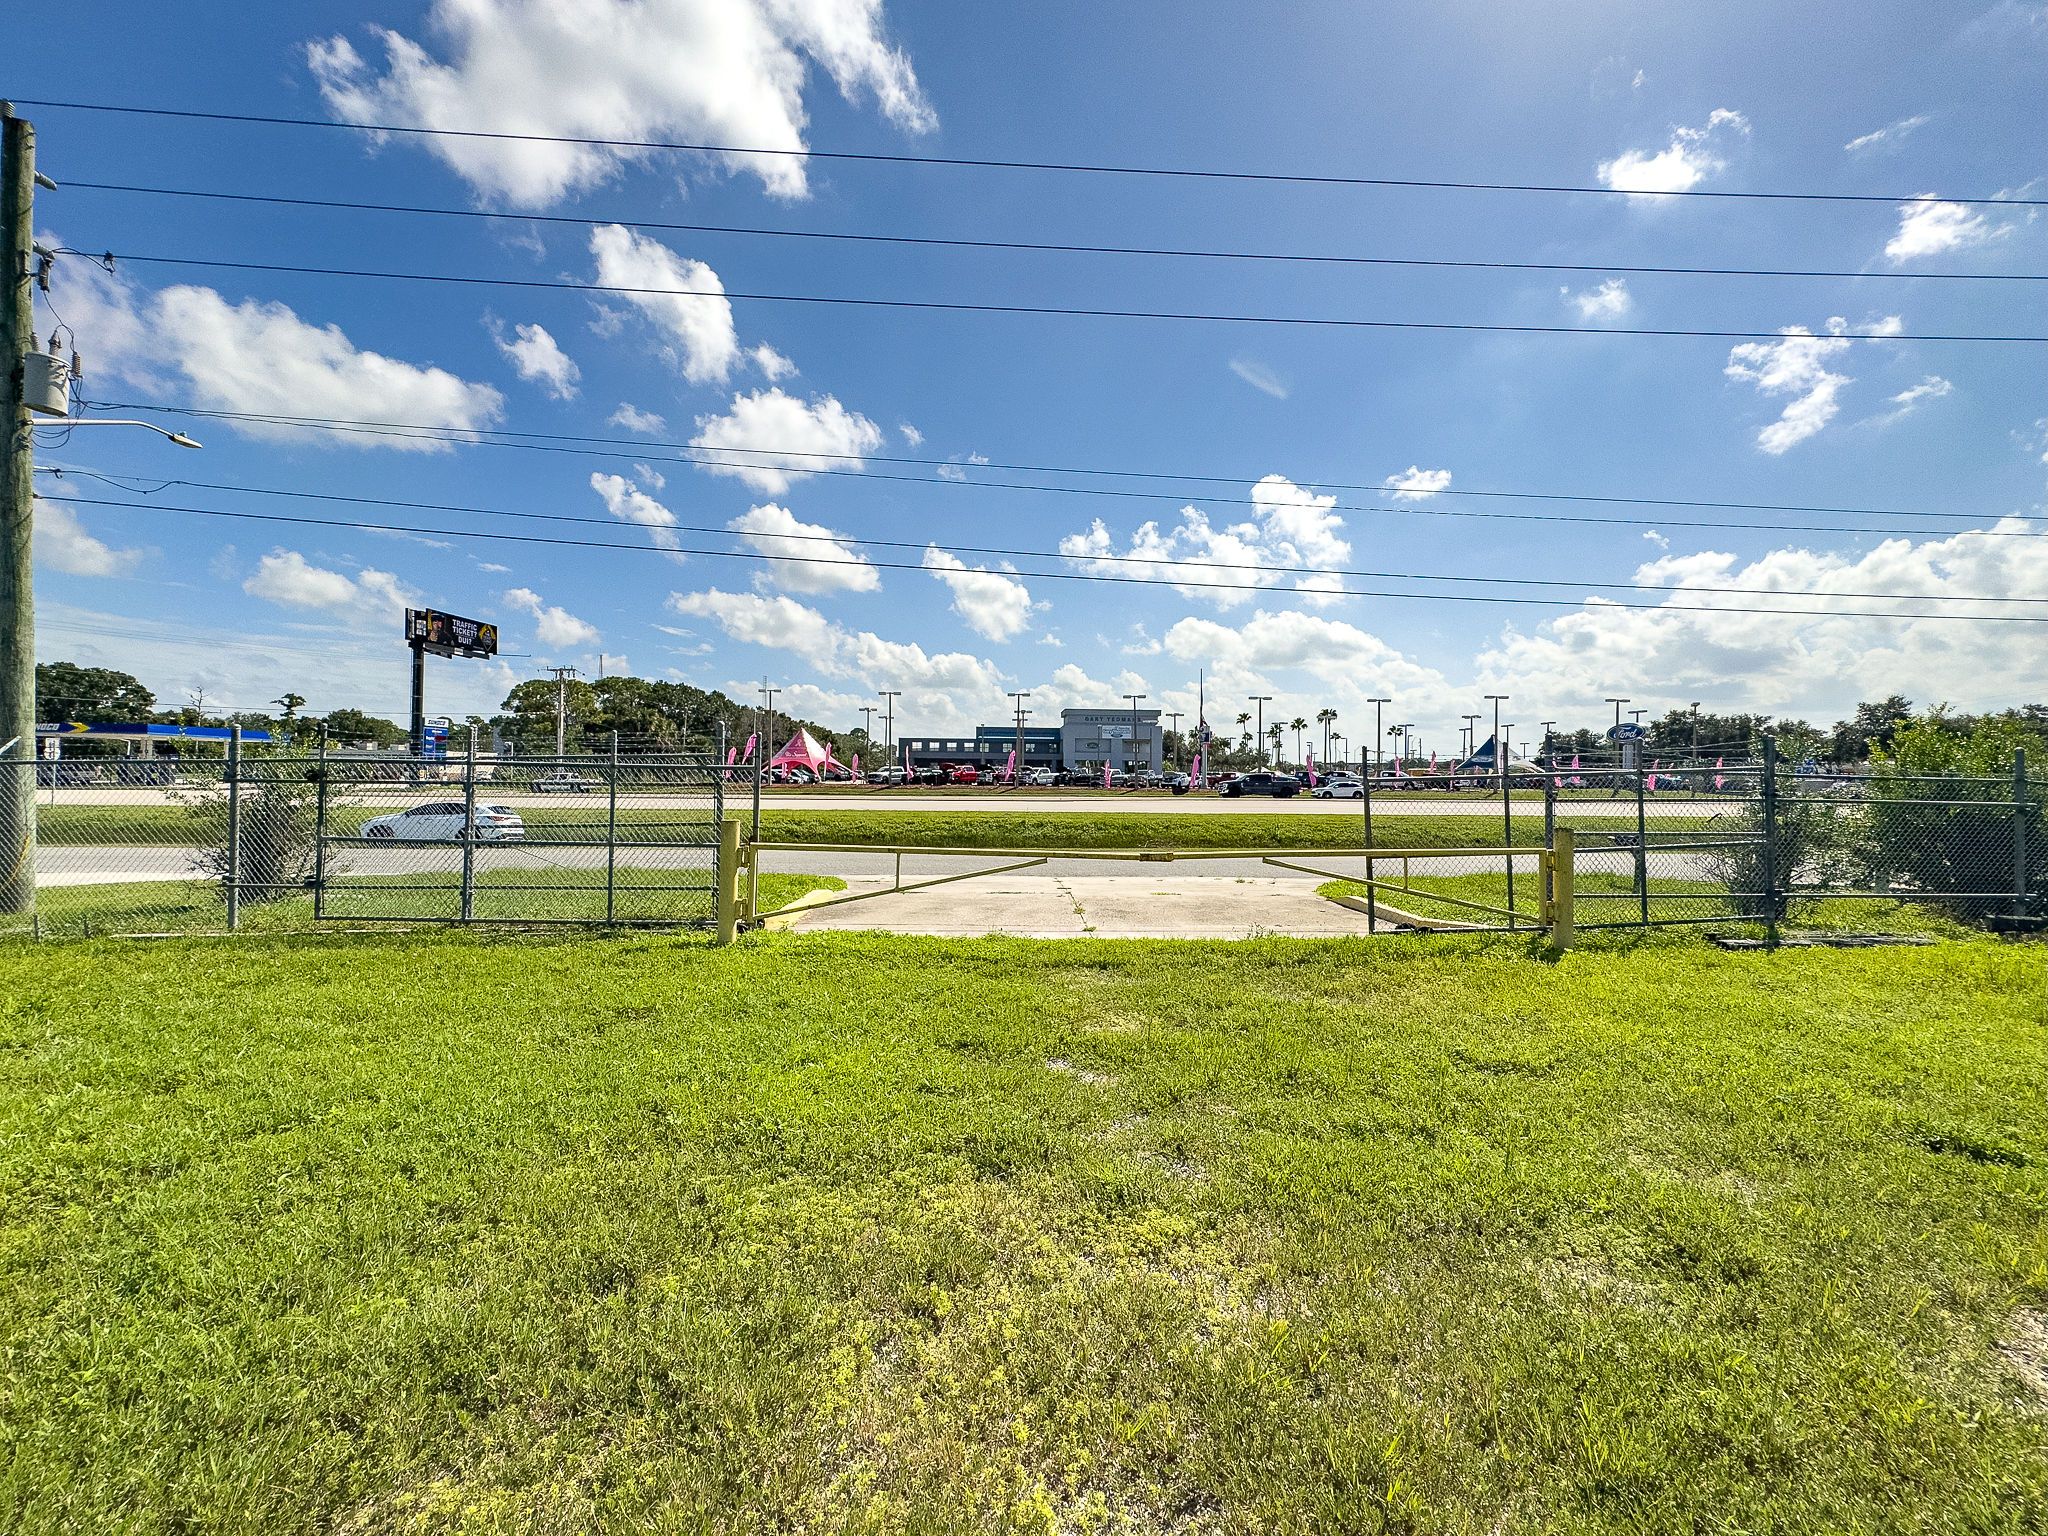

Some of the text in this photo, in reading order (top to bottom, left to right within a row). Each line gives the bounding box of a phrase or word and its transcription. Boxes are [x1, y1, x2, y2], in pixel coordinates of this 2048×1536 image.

[452, 619, 477, 631] TRAFFIC
[452, 626, 478, 638] TICKET?
[458, 636, 472, 645] DUI?
[1614, 727, 1637, 738] Ford
